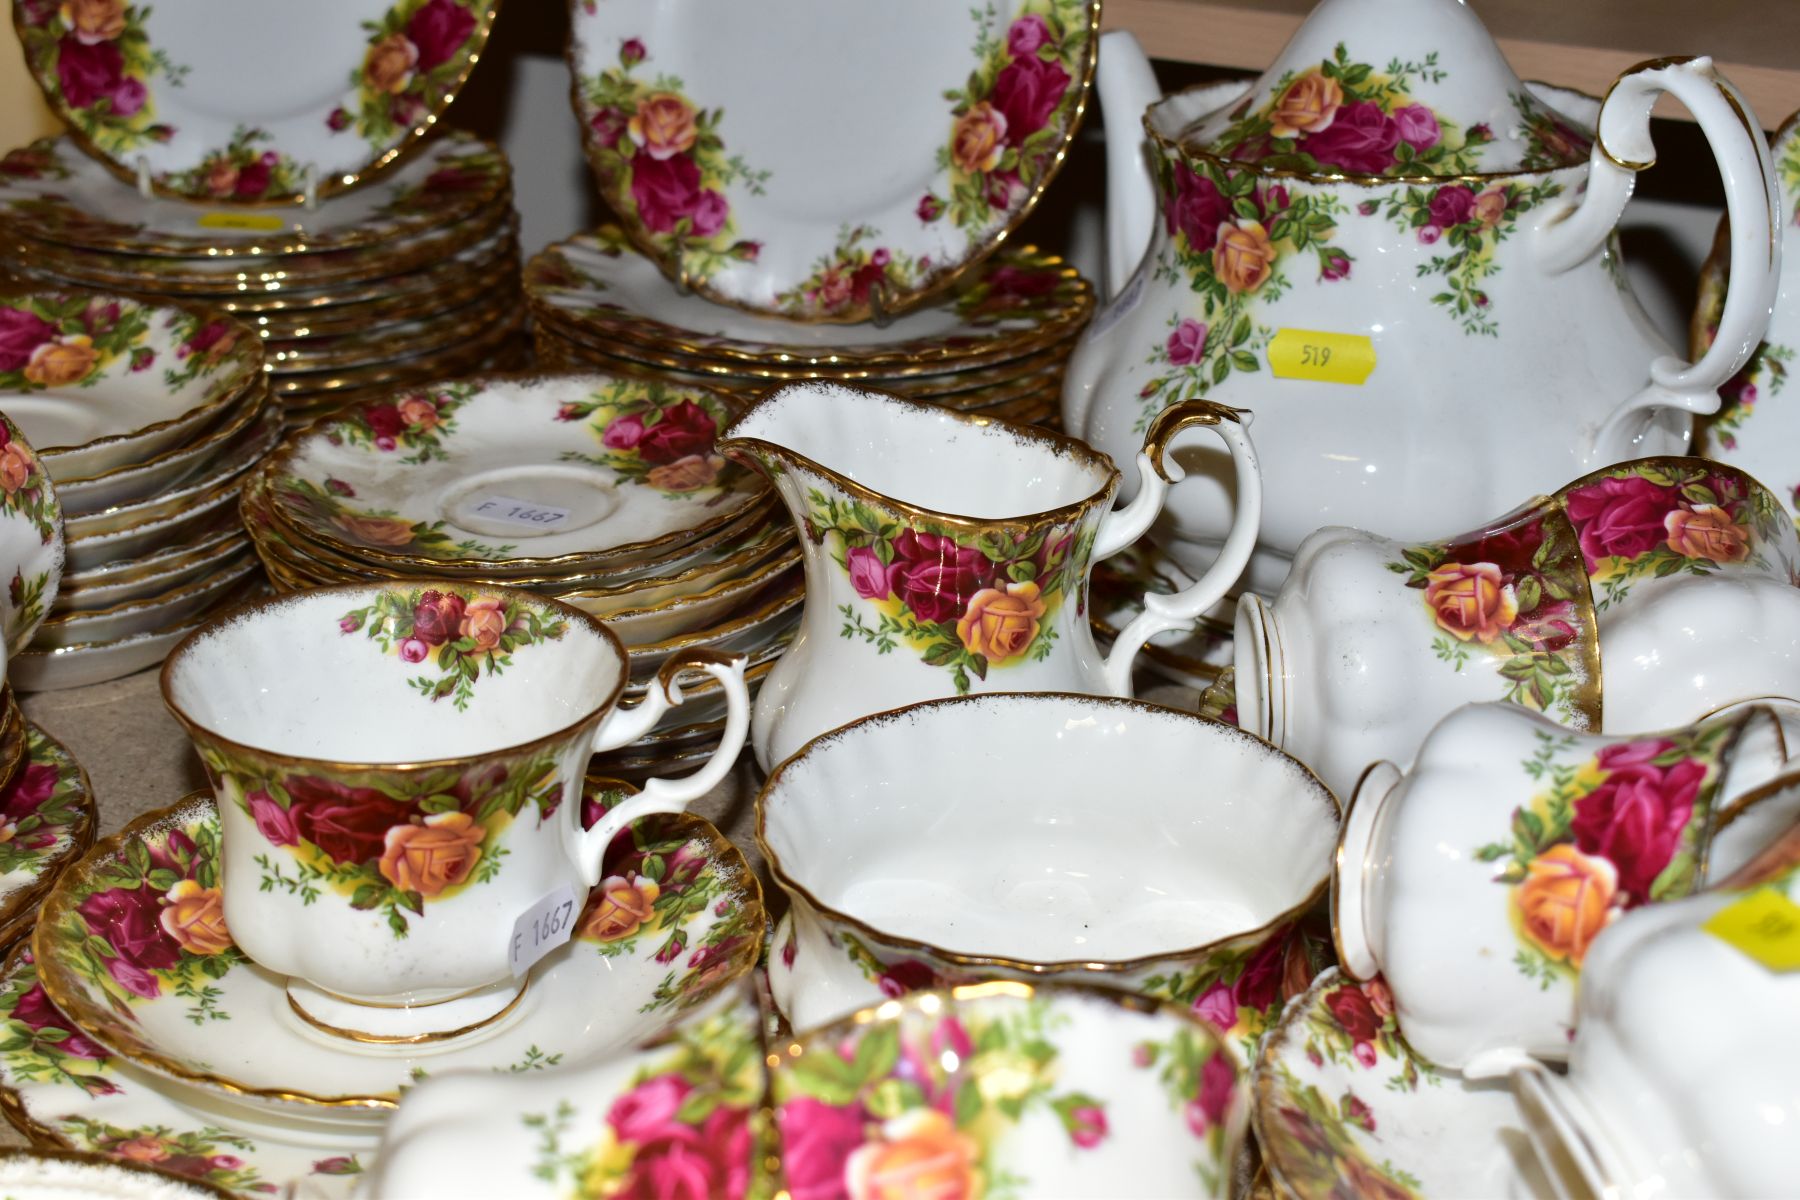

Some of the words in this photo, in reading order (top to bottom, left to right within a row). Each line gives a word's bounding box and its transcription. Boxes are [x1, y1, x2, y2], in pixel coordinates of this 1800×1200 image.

[1300, 344, 1332, 367] 519
[477, 501, 497, 511] F
[507, 507, 565, 523] 1667
[513, 931, 523, 963] F
[532, 898, 573, 947] 1667
